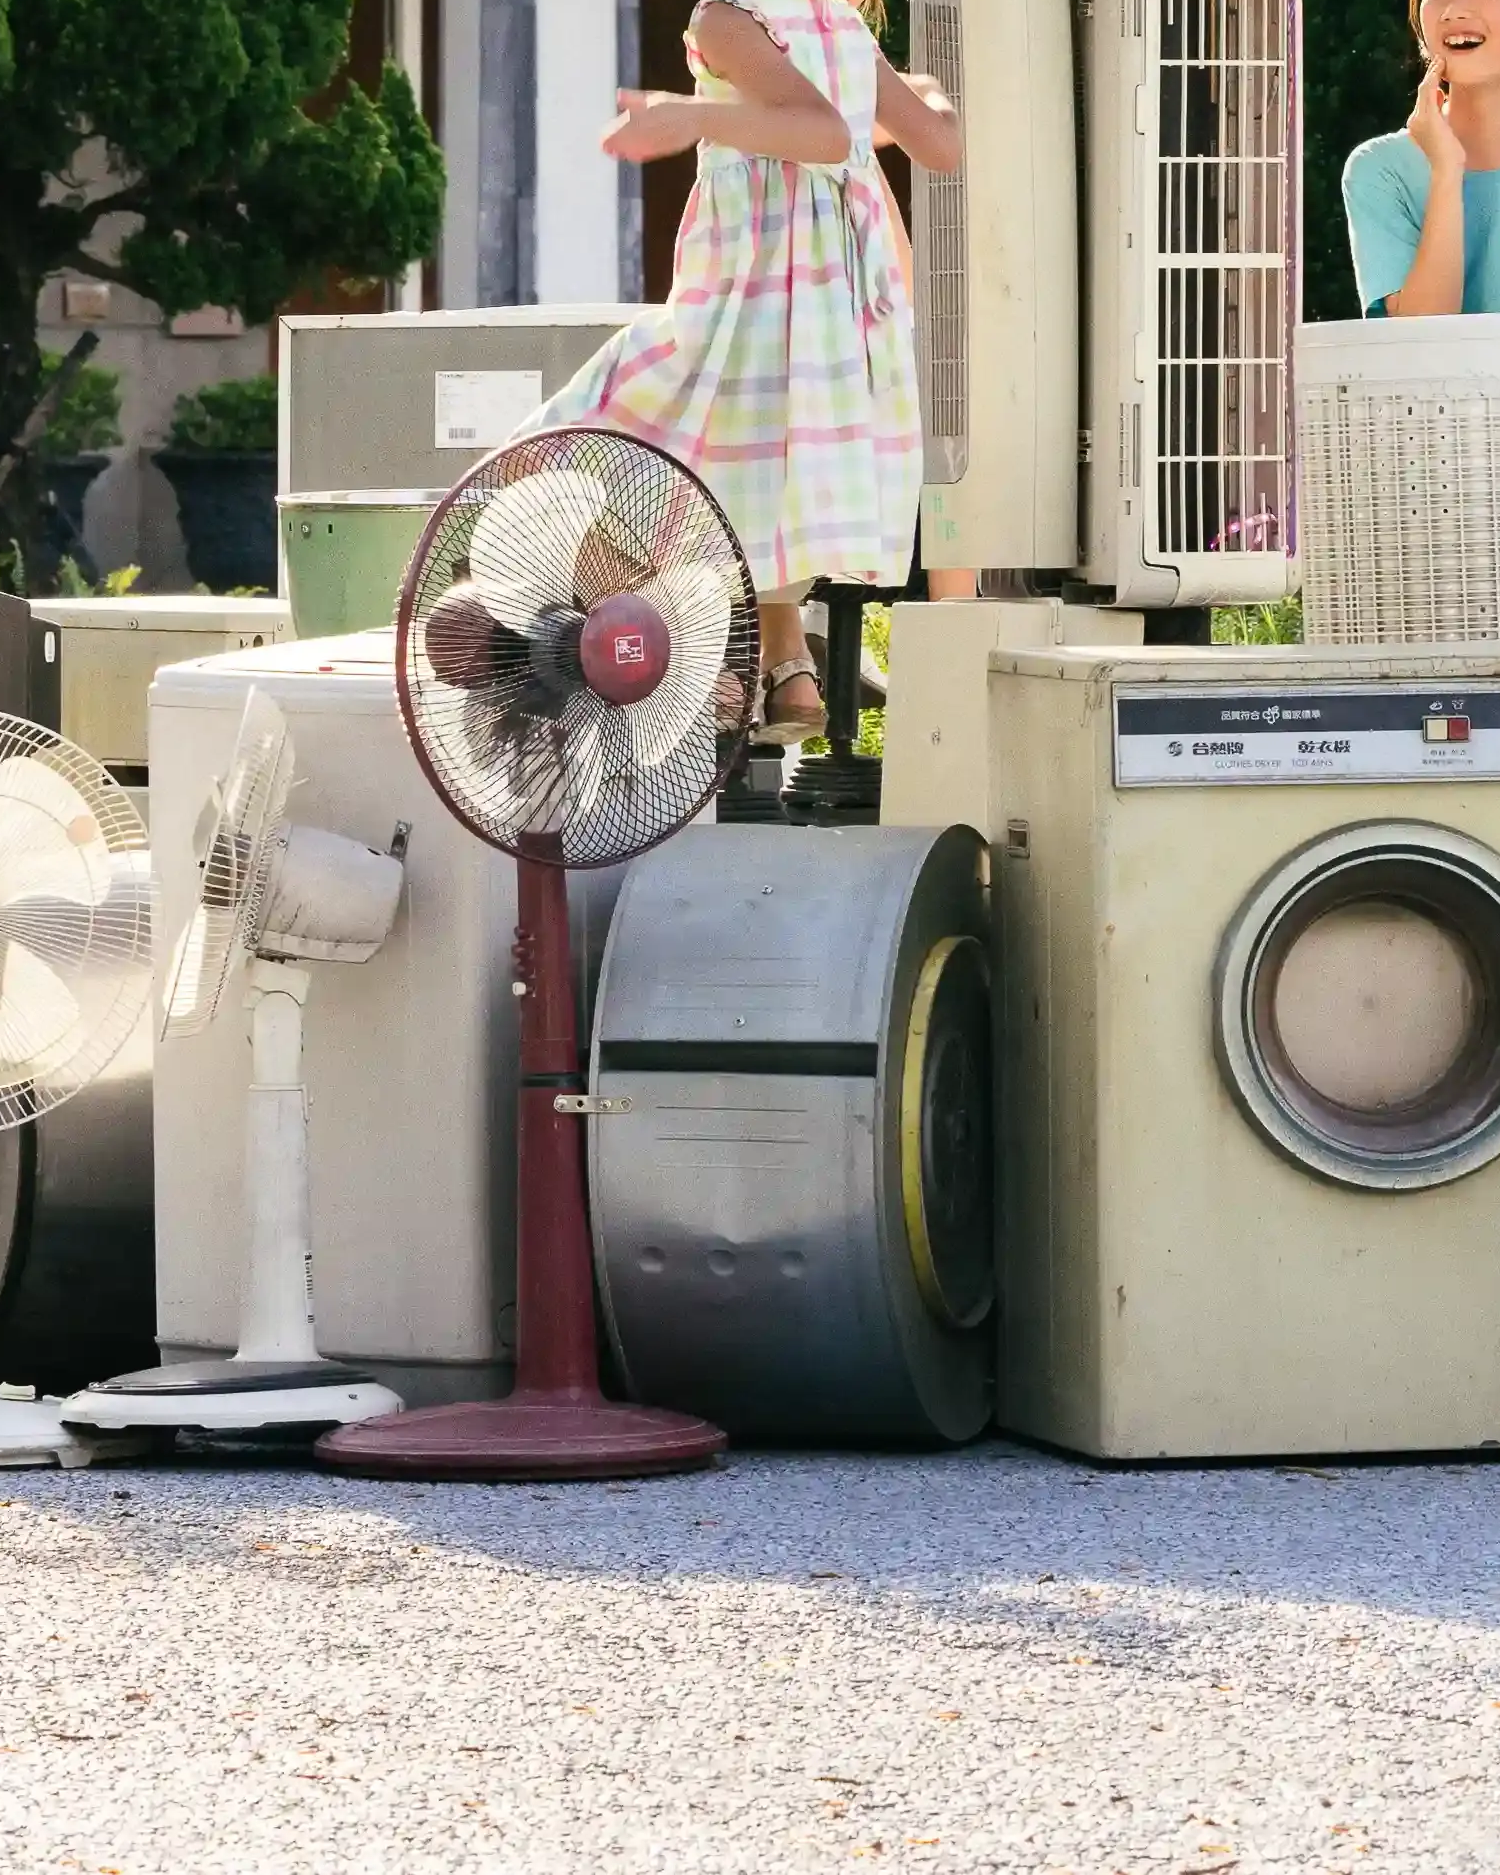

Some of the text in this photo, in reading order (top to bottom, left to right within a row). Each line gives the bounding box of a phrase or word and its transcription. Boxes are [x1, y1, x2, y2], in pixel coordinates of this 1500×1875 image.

[1192, 739, 1351, 756] 台熱牌 乾衣機
[1214, 758, 1253, 769] CLOTHES
[1255, 758, 1282, 768] DRYER
